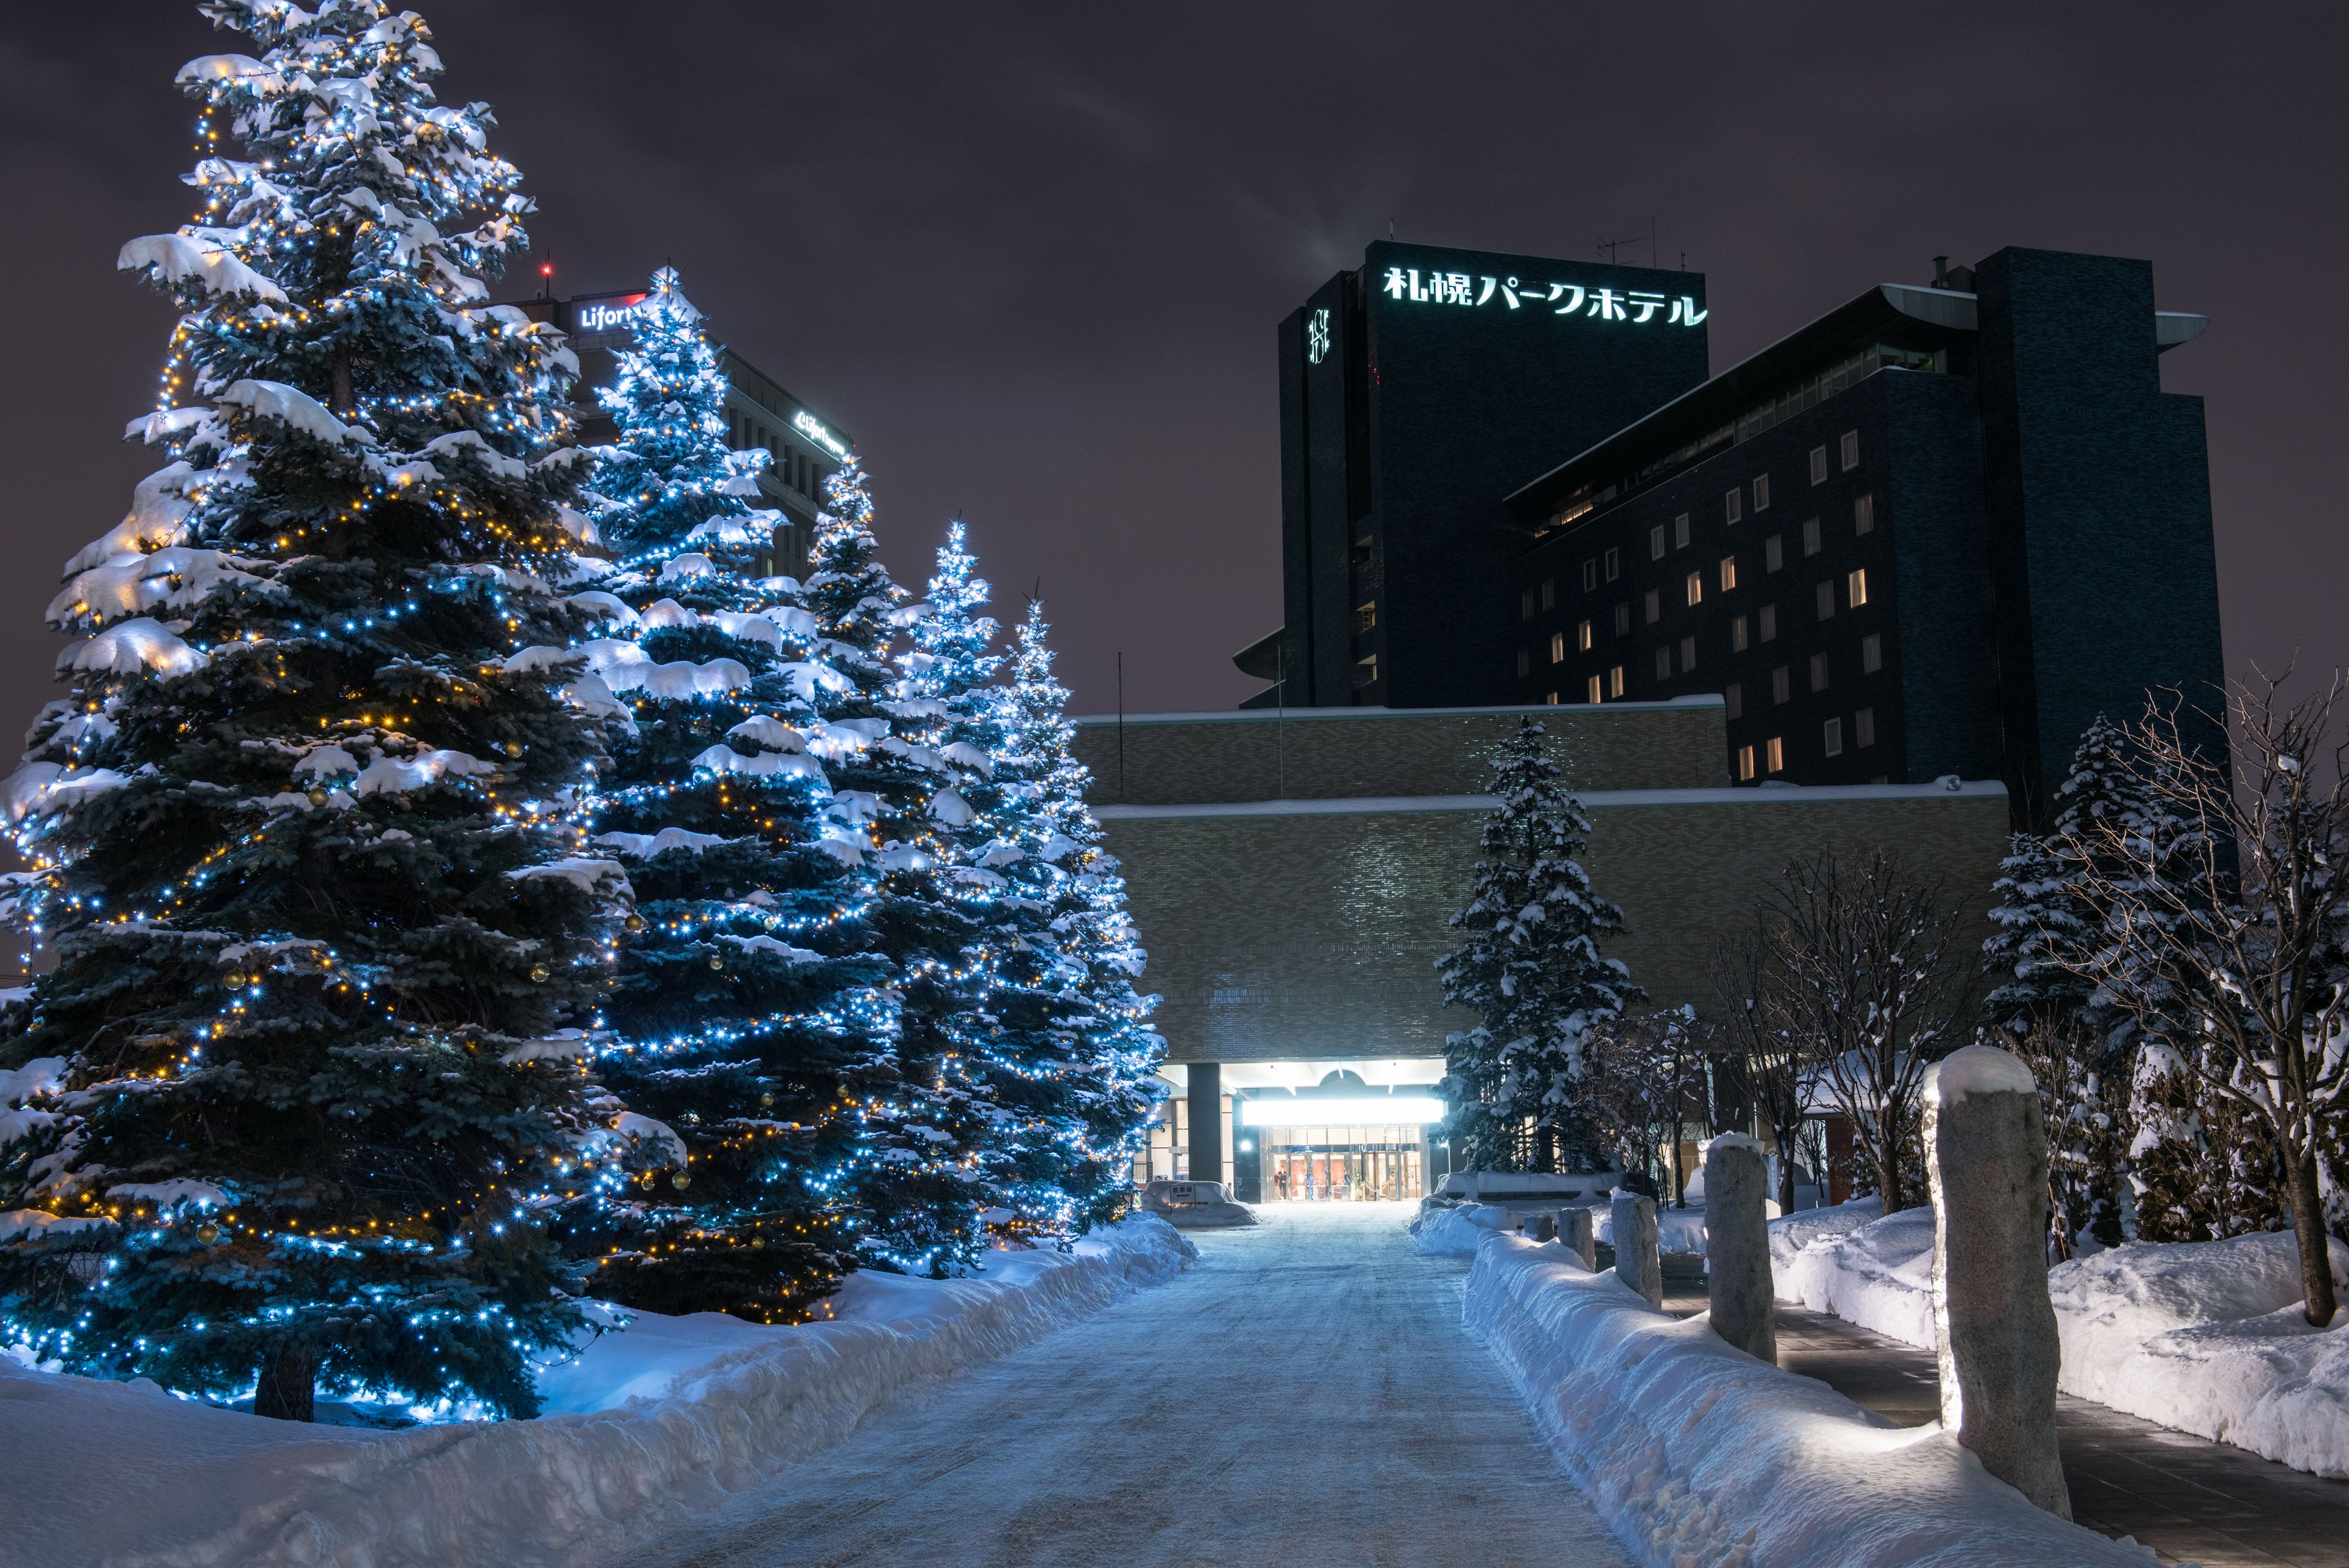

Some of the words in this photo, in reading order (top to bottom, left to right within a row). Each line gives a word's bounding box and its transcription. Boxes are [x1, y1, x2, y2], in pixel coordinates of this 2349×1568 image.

[582, 305, 633, 330] Lifort
[1384, 267, 1708, 327] 札幌パークホテル
